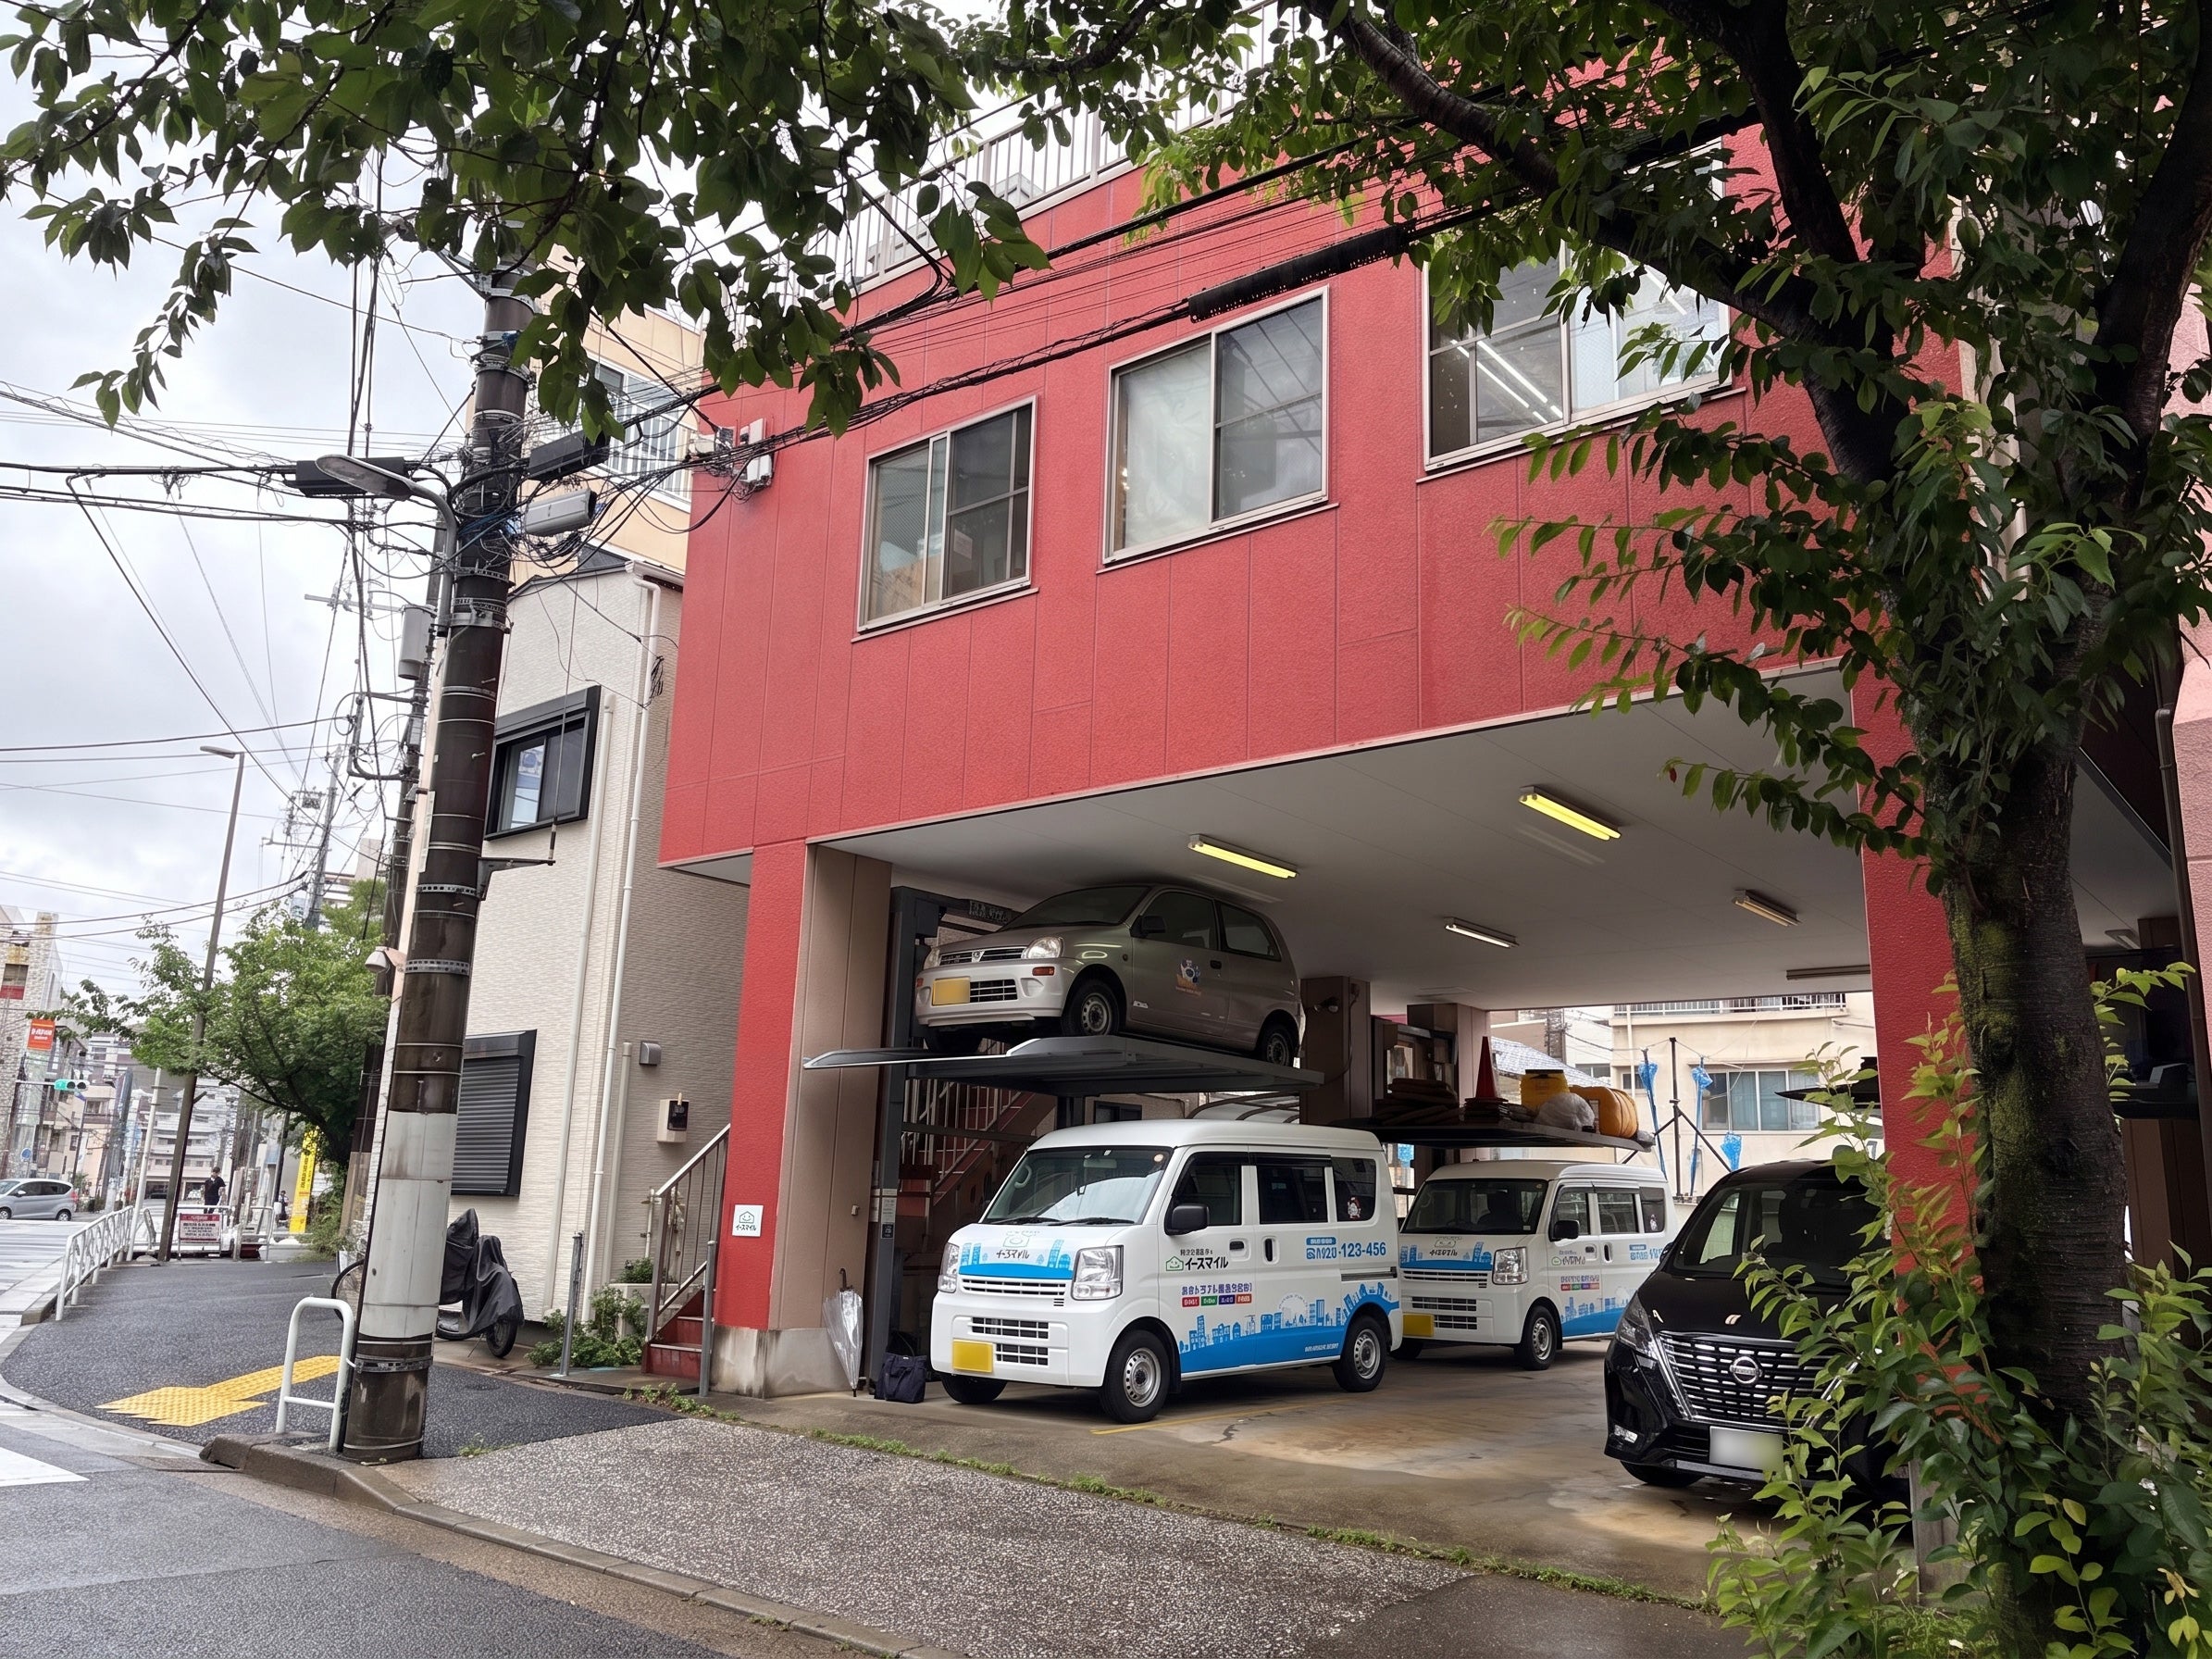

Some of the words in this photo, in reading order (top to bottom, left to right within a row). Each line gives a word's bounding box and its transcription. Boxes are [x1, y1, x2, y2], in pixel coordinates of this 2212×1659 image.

[1185, 1256, 1229, 1271] イースマイル
